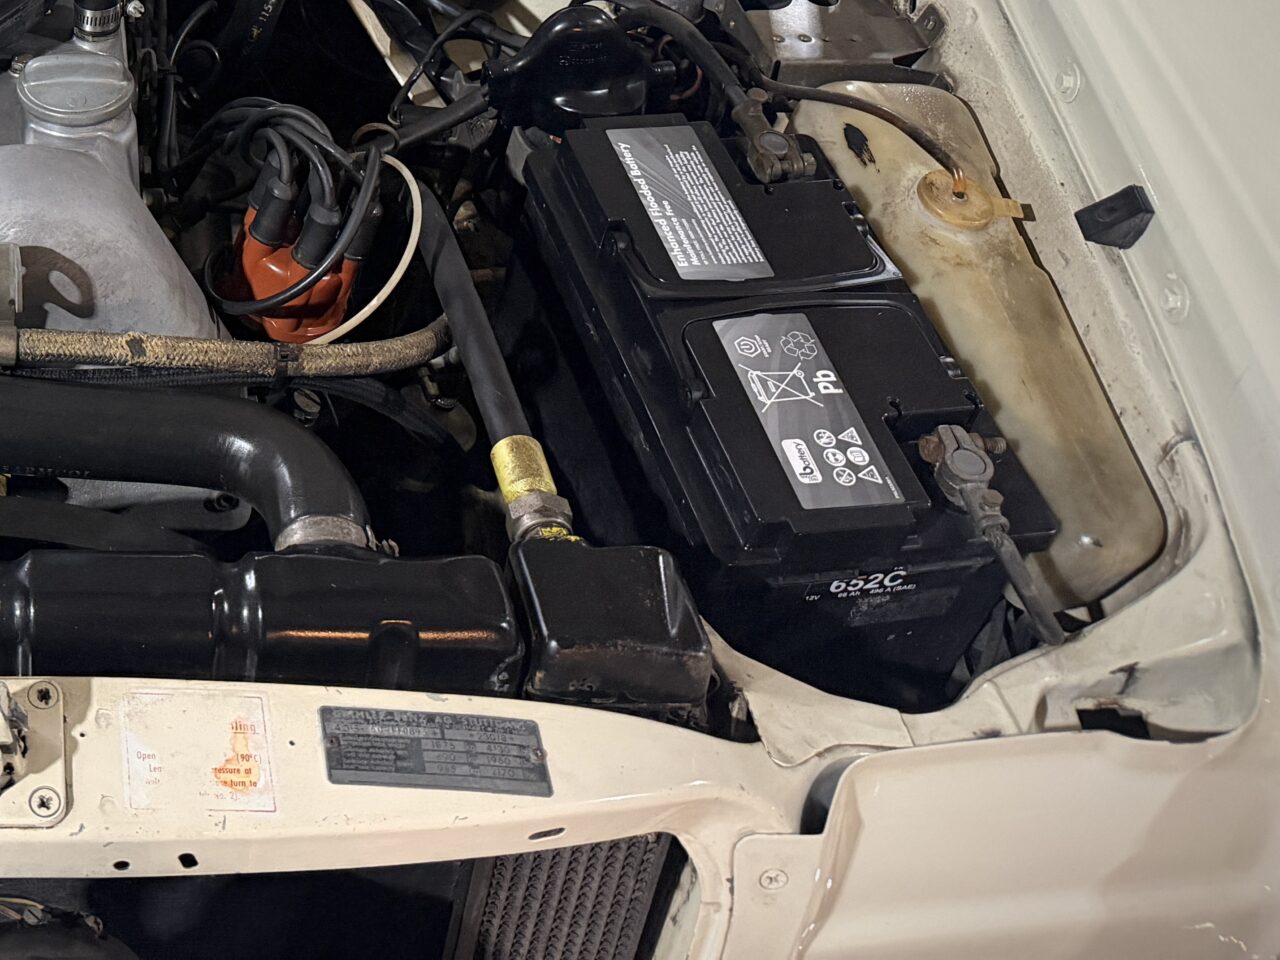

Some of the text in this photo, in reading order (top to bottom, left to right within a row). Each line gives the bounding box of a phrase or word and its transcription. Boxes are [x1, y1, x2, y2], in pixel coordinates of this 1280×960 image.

[618, 142, 688, 267] Enhanced Flooded Battery
[663, 200, 674, 217] Free
[671, 217, 701, 266] Maintenance
[813, 370, 843, 394] Pb
[829, 570, 907, 593] 652C
